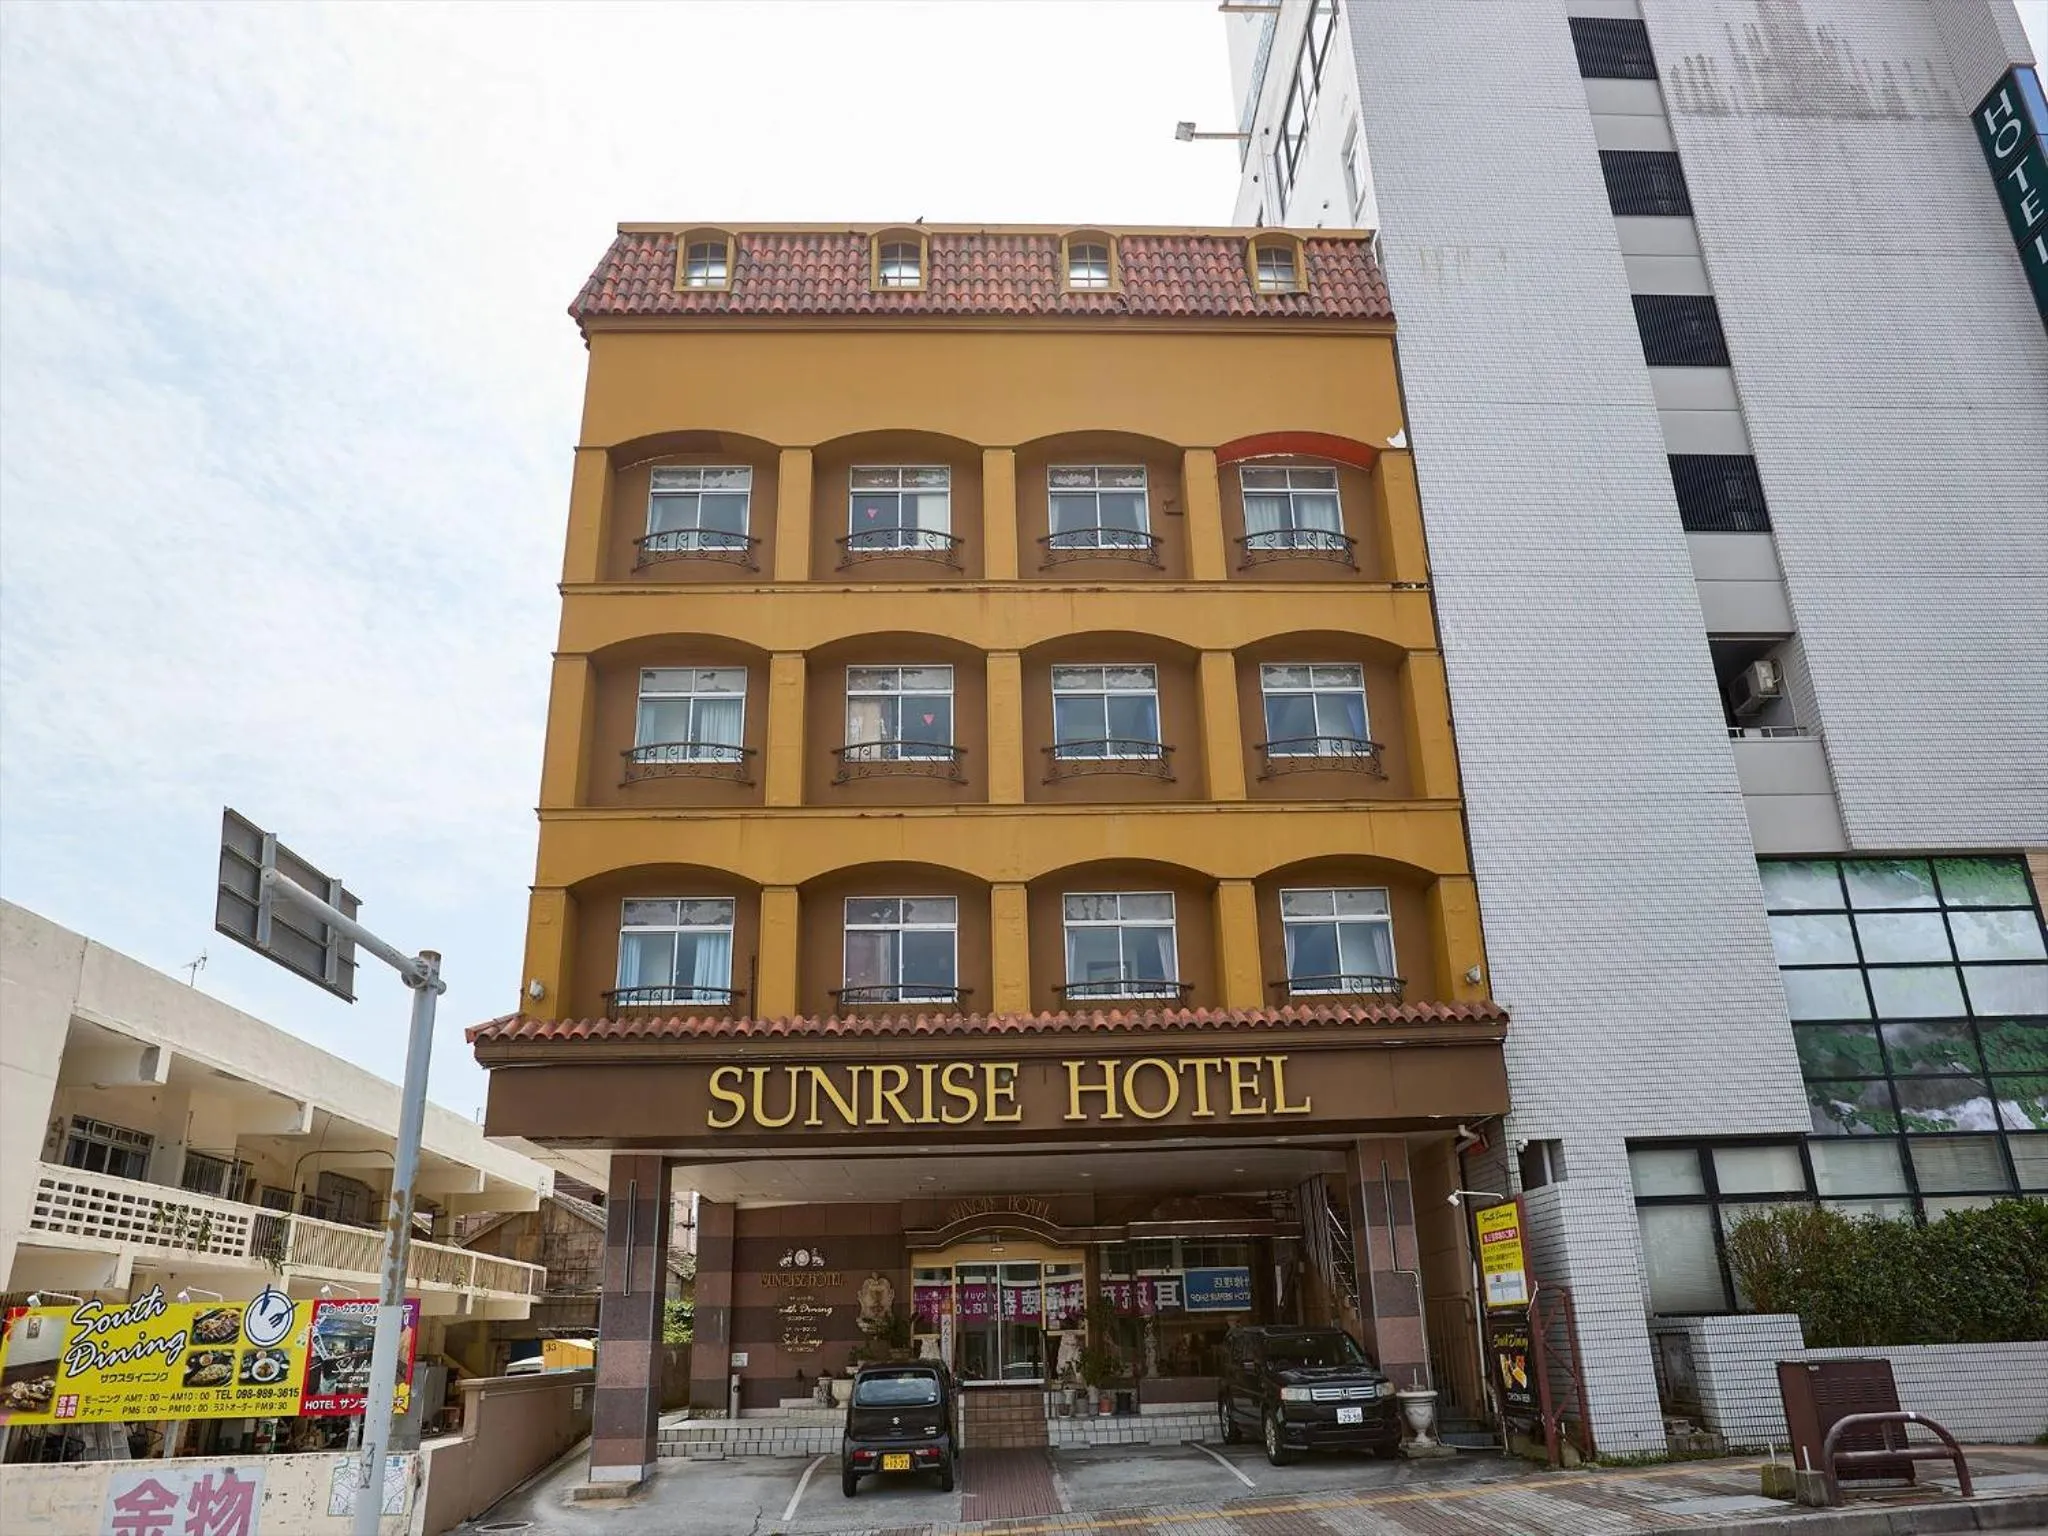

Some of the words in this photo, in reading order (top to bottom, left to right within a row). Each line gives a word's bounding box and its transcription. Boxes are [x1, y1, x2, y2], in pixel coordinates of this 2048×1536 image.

[707, 1064, 1022, 1128] SUNRISE
[1062, 1056, 1311, 1120] HOTEL
[71, 1284, 168, 1345] South
[545, 1342, 557, 1352] 33
[64, 1330, 187, 1378] Dining
[85, 1394, 121, 1405] モーニング
[215, 1389, 233, 1400] TEL
[305, 1400, 337, 1410] HOTEL
[340, 1398, 368, 1409] サンラ
